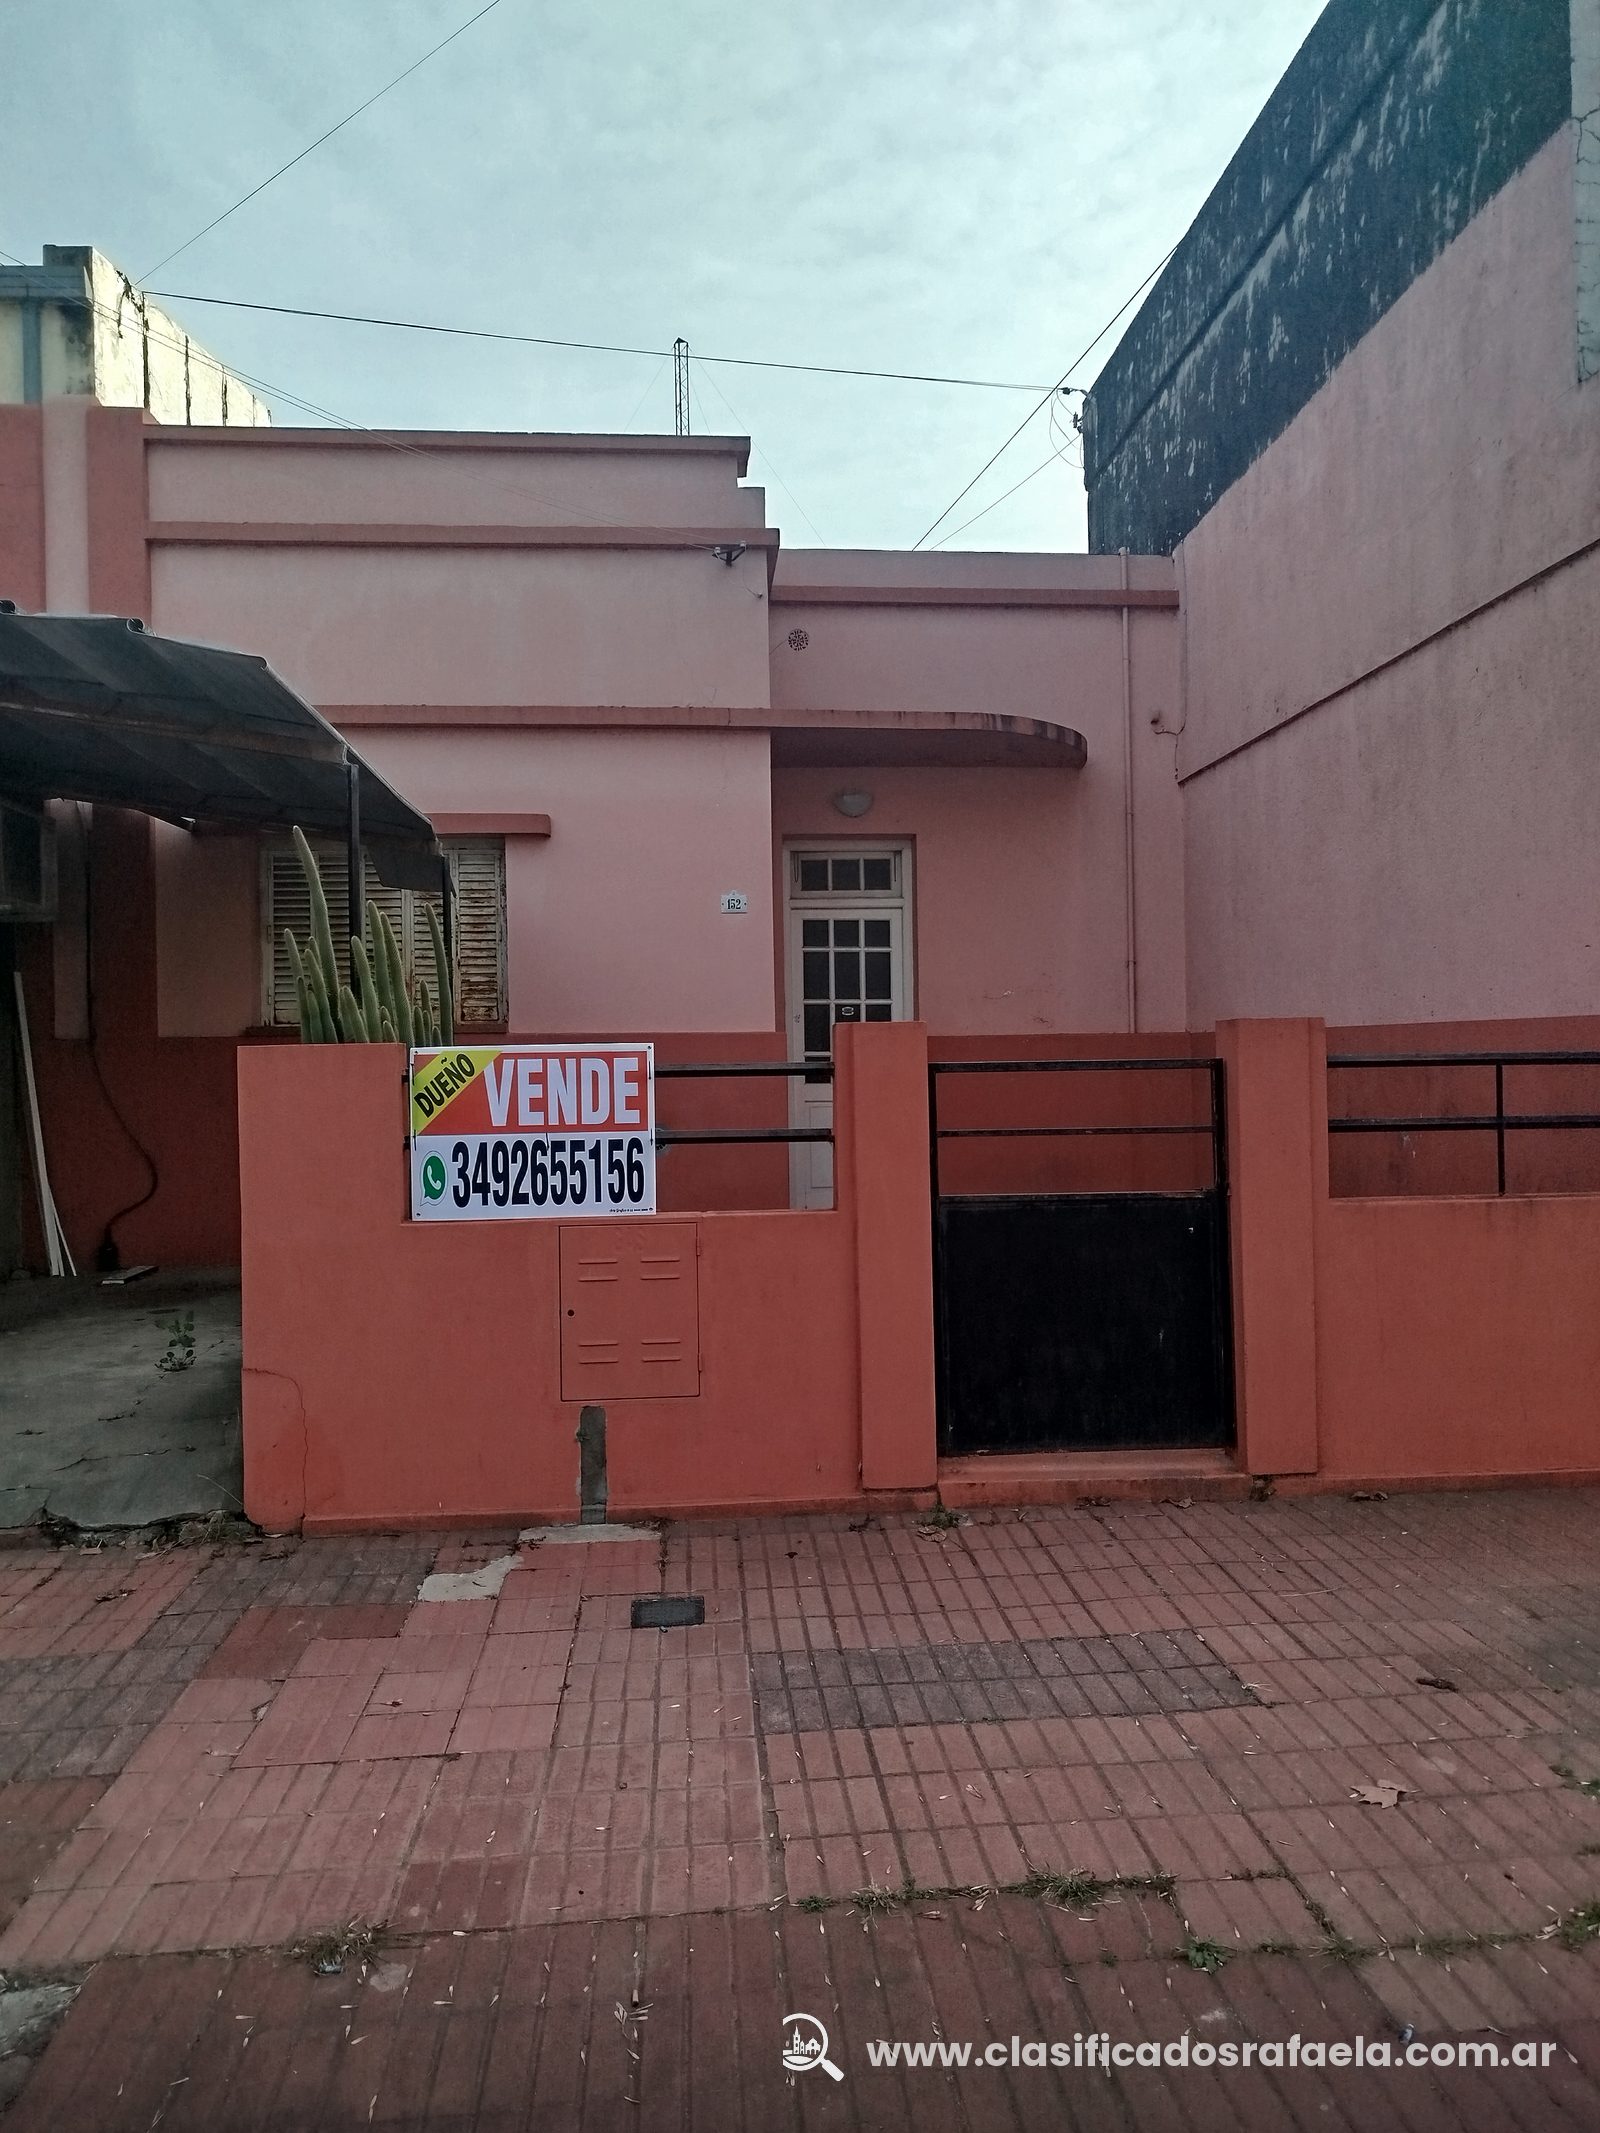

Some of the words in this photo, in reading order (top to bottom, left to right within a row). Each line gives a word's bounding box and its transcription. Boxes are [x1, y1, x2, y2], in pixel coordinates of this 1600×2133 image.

[727, 898, 741, 909] 152
[413, 1053, 475, 1117] DUEÑO
[484, 1057, 641, 1126] VENDE
[451, 1137, 644, 1208] 3492655156
